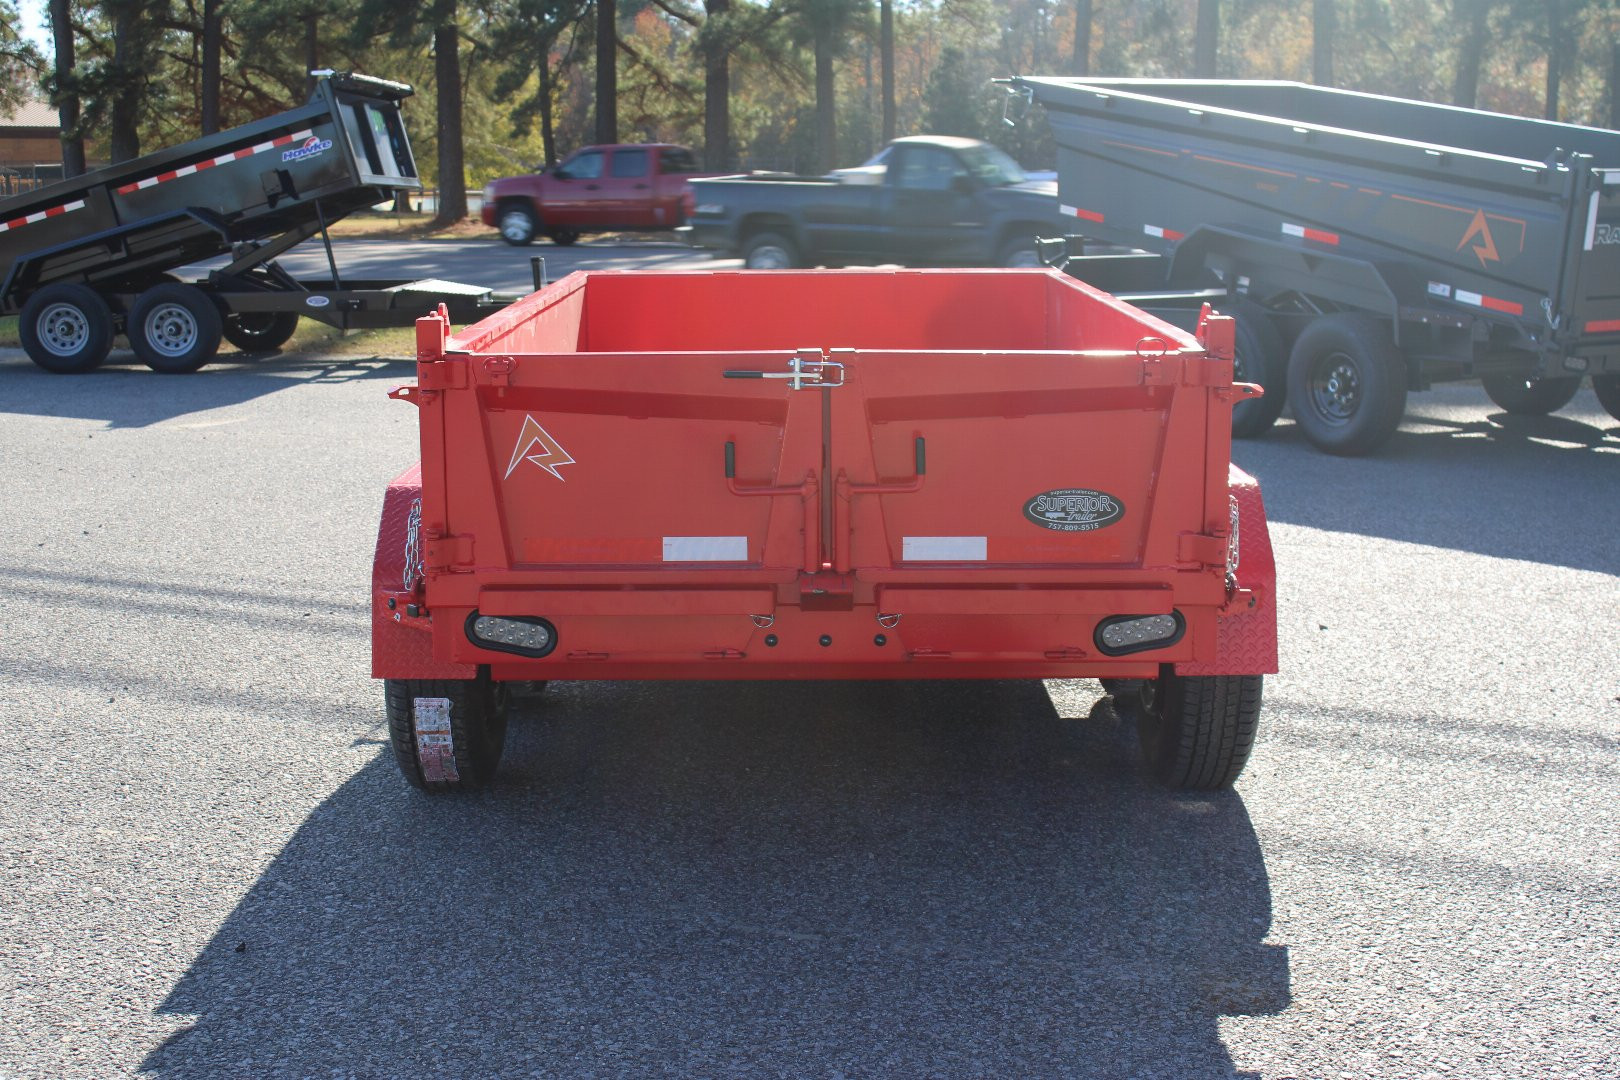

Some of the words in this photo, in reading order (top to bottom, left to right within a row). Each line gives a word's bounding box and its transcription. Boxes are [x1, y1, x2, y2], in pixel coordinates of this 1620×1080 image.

[282, 139, 332, 162] Hawke
[1037, 495, 1112, 512] SUPERIOR
[1067, 510, 1098, 521] Trailer
[1048, 522, 1099, 531] 757-809-5515
